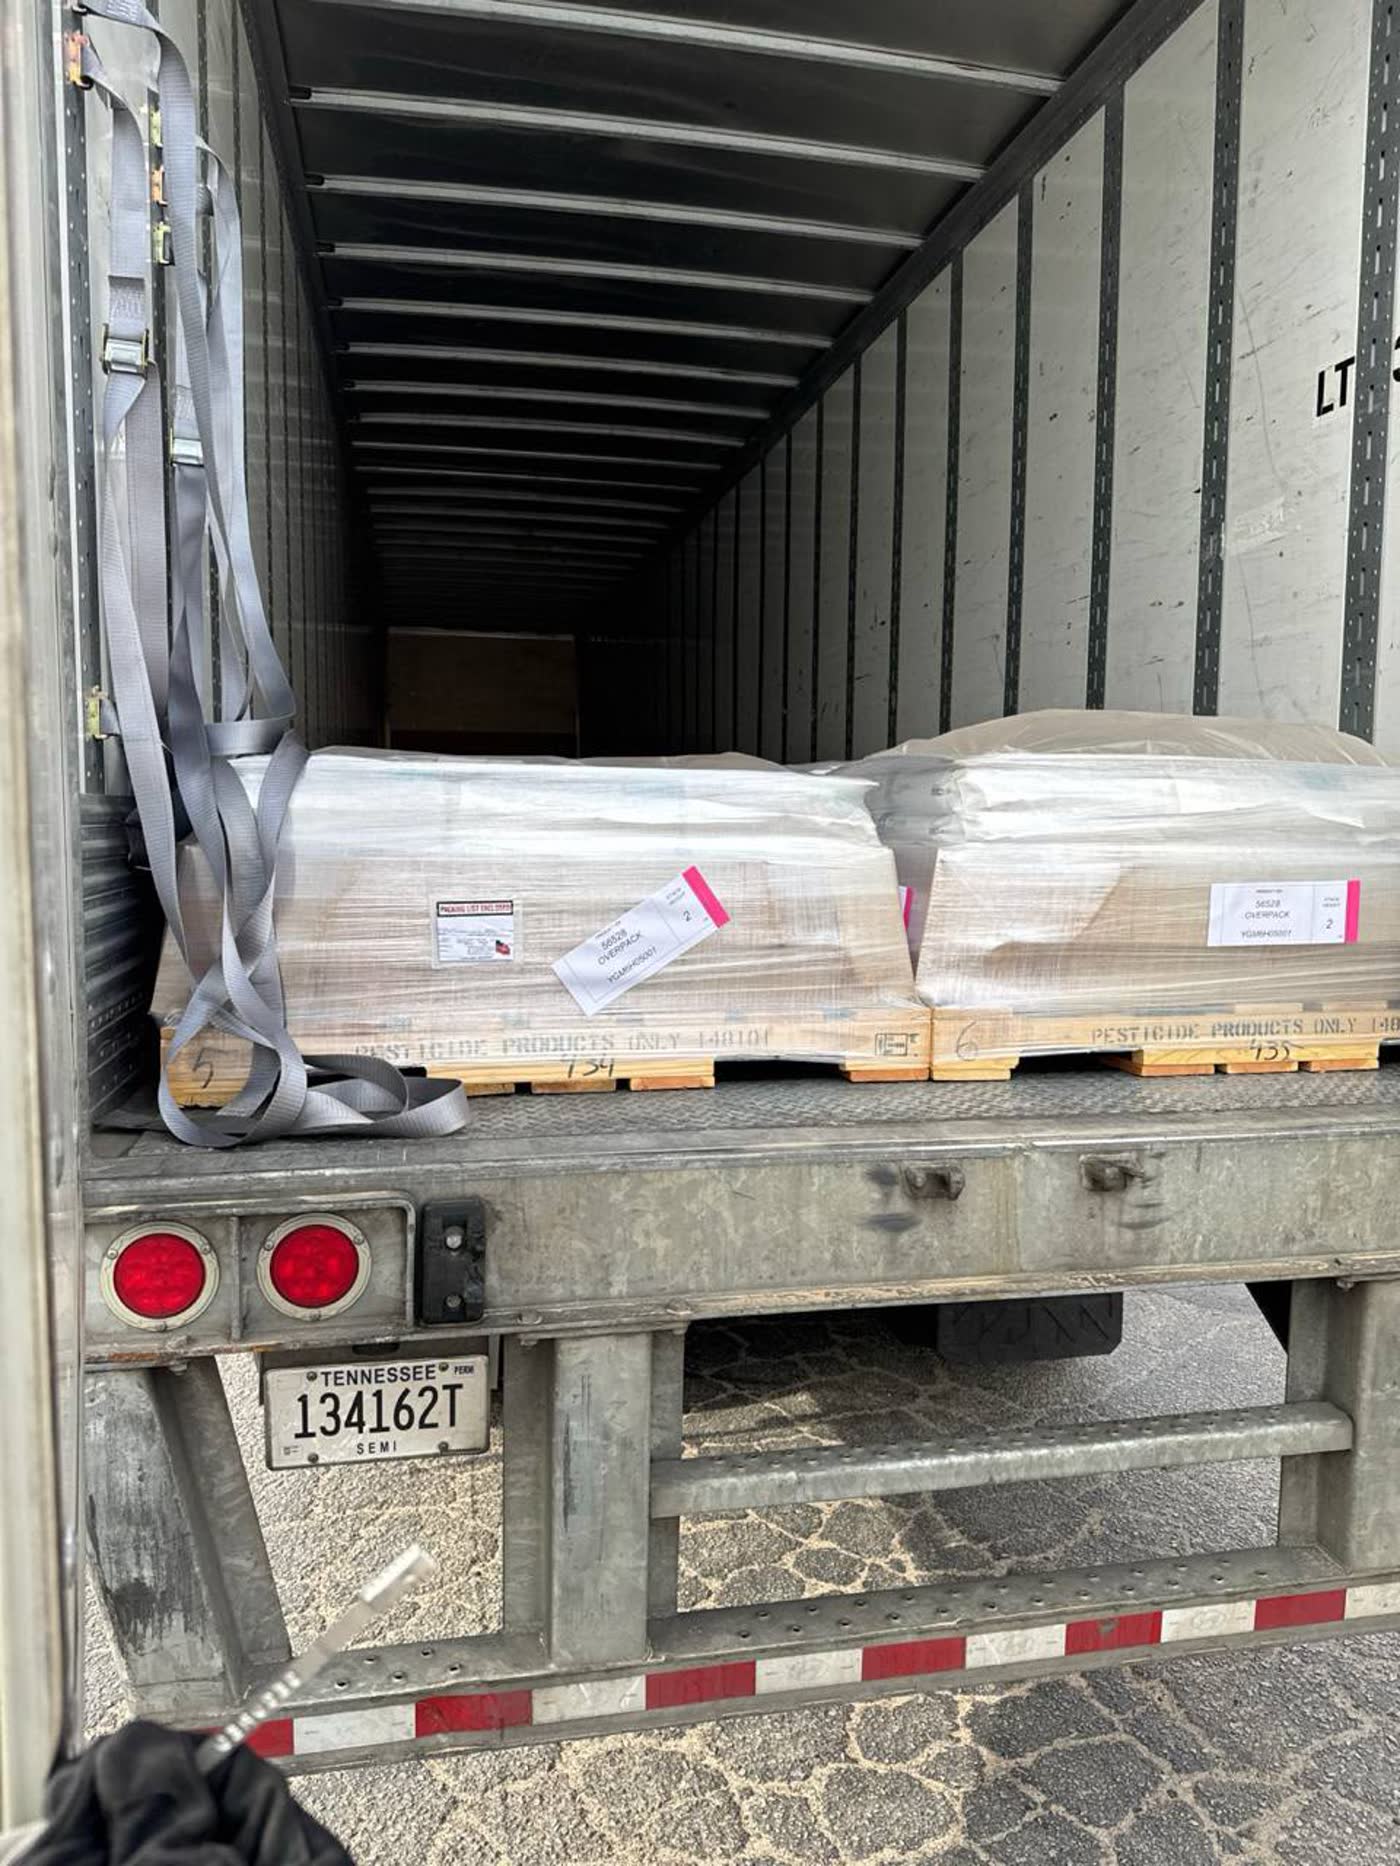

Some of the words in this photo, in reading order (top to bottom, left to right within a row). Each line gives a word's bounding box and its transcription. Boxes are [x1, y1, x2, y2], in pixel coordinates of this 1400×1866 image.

[1316, 355, 1356, 418] LT
[682, 910, 693, 922] 2
[1244, 910, 1291, 920] OVERPACK
[1325, 918, 1334, 930] 2
[597, 930, 644, 966] OVERPACK
[601, 927, 628, 951] 56528
[1091, 1022, 1200, 1044] PESTICIDE
[1210, 1018, 1303, 1038] PRODUCTS
[1313, 1017, 1356, 1034] ONLY
[502, 1034, 615, 1055] PRODUCTS
[628, 1031, 681, 1050] ONLY
[321, 1364, 437, 1387] TENNESSEE
[453, 1365, 475, 1376] PERM
[294, 1383, 464, 1439] 134162T
[356, 1440, 397, 1455] SEMI
